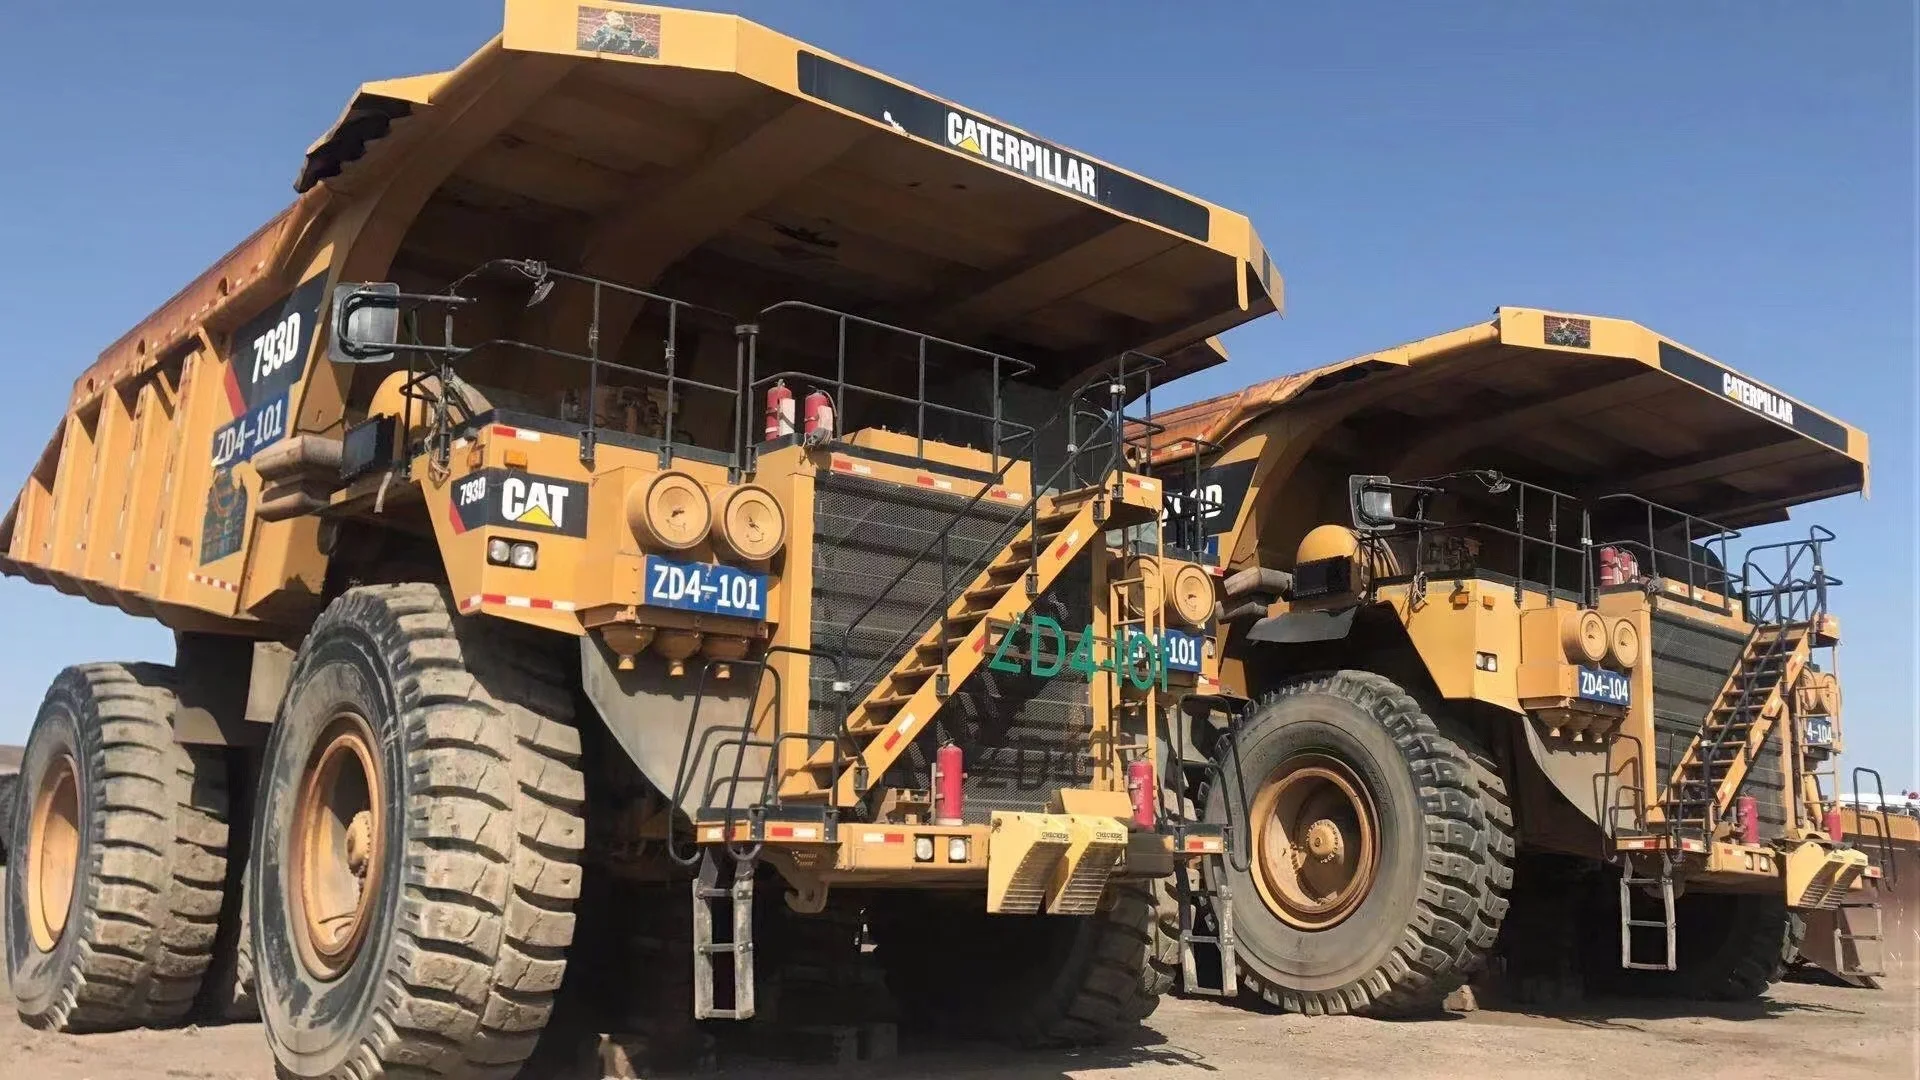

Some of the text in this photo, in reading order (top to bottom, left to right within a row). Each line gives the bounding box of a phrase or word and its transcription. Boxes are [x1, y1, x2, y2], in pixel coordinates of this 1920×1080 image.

[948, 111, 1096, 197] CATERPILLAR
[252, 312, 301, 384] 793D
[1723, 372, 1794, 426] CATERPILLAR
[211, 399, 283, 468] ZD4-101
[460, 476, 486, 506] 793D
[501, 477, 570, 528] CAT
[652, 564, 760, 611] ZD4-101
[1581, 671, 1629, 702] ZD4-104
